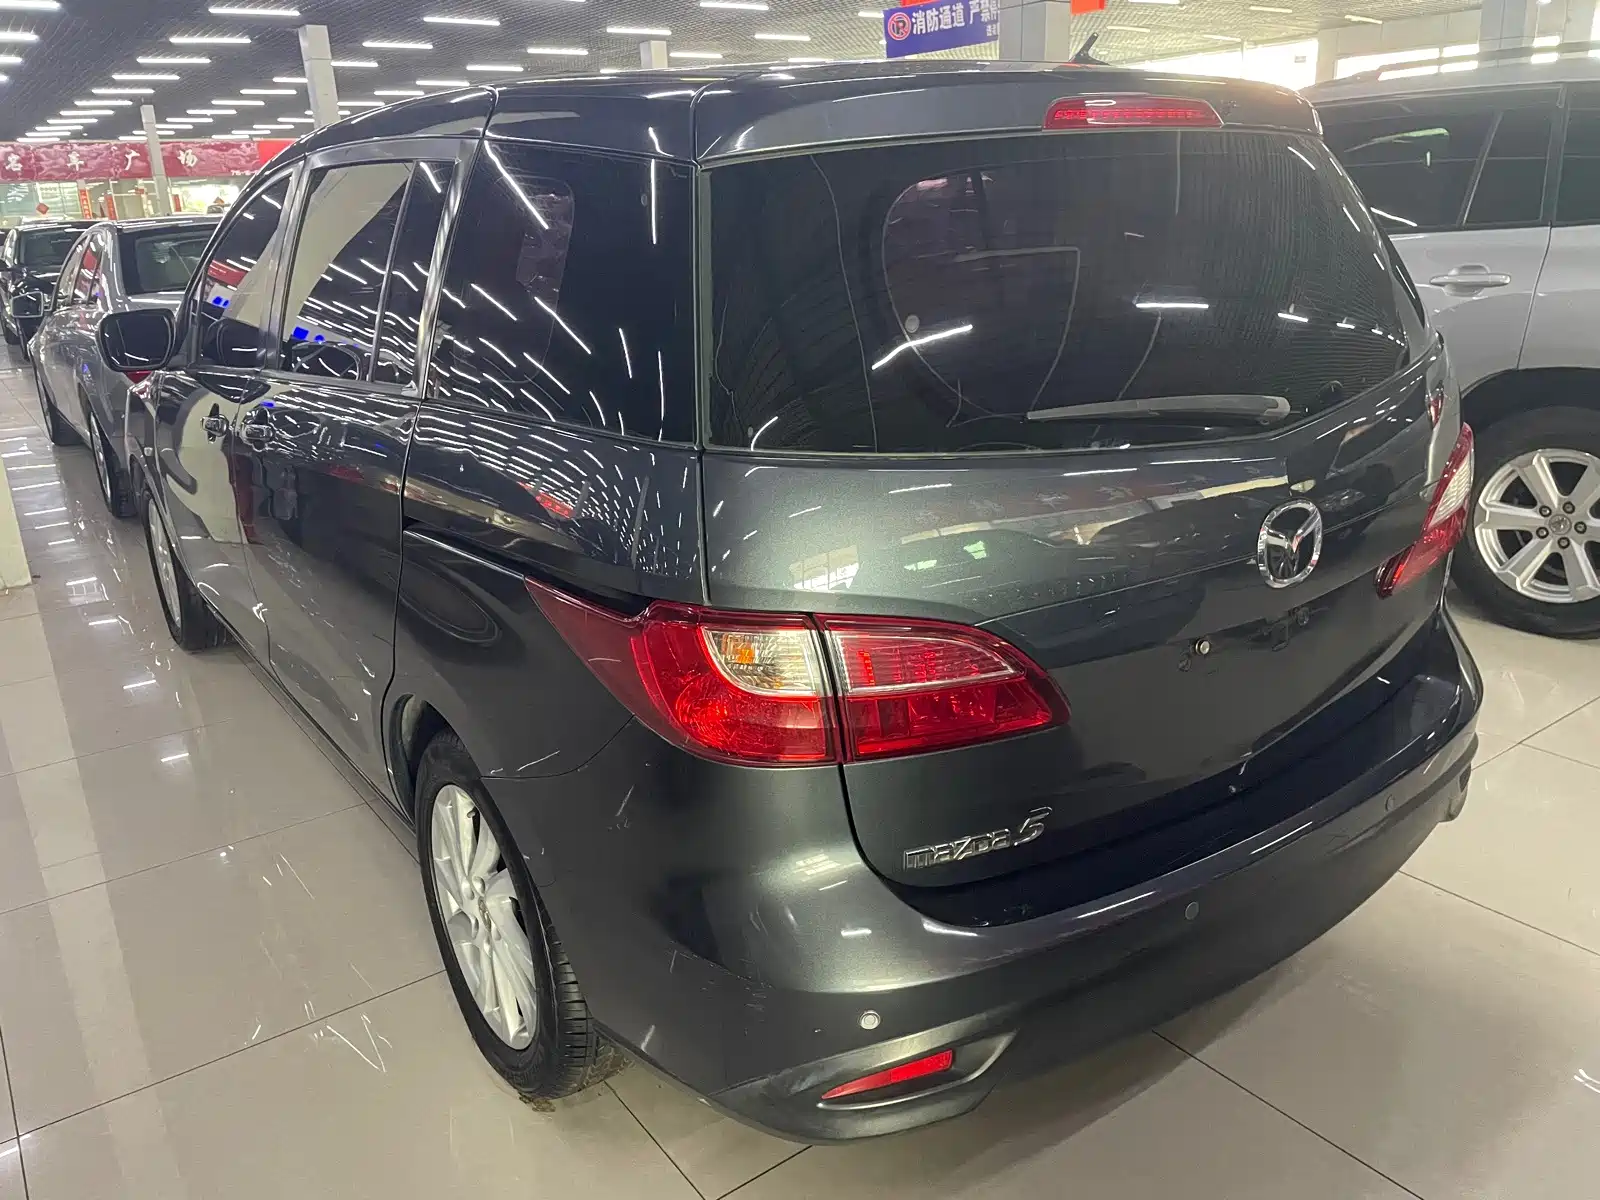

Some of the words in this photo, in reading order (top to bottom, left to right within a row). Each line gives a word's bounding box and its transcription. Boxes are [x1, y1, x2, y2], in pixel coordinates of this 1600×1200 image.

[911, 3, 966, 34] 消防通道
[903, 828, 1012, 871] mazda
[1014, 806, 1053, 847] 5
